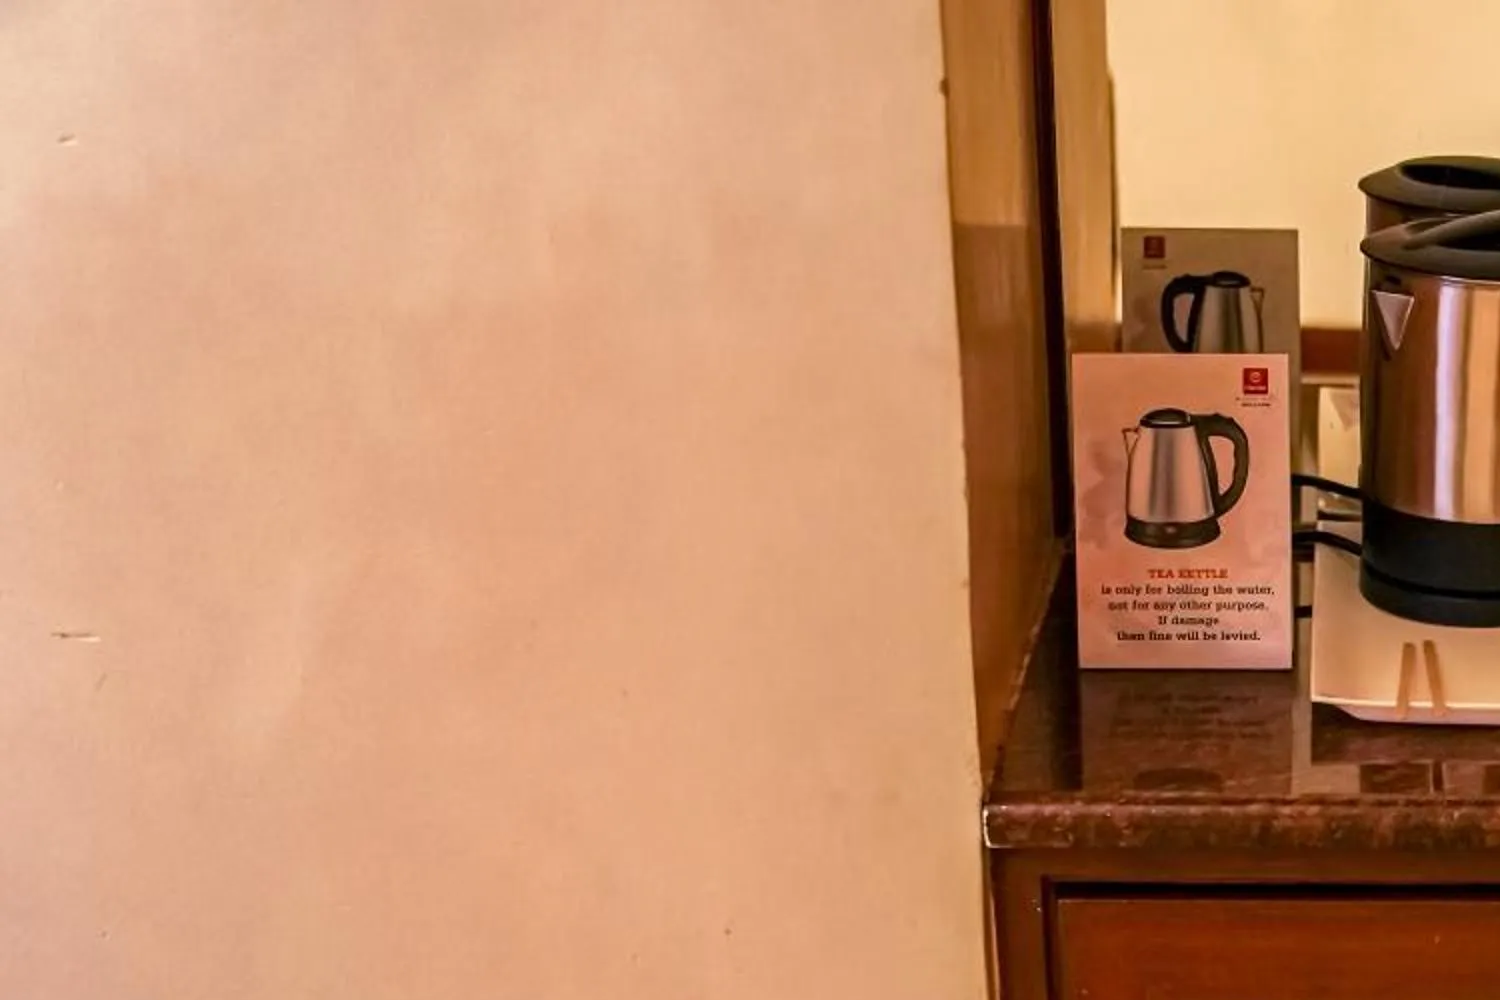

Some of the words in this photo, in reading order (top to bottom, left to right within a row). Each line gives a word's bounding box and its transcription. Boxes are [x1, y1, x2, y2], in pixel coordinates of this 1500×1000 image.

[1149, 569, 1175, 579] TEA
[1177, 569, 1228, 579] KETTLE
[1101, 585, 1112, 595] is
[1115, 585, 1142, 596] only
[1145, 584, 1162, 595] for
[1167, 585, 1209, 597] boiling
[1213, 585, 1233, 595] the
[1108, 602, 1128, 611] not
[1131, 601, 1150, 611] for
[1153, 602, 1176, 612] any
[1179, 601, 1212, 611] other
[1158, 616, 1167, 625] If
[1171, 615, 1219, 627] damage
[1117, 631, 1145, 641] then
[1149, 631, 1172, 641] fine
[1175, 631, 1199, 641] will
[1203, 631, 1217, 641] be
[1221, 631, 1261, 641] levied.
